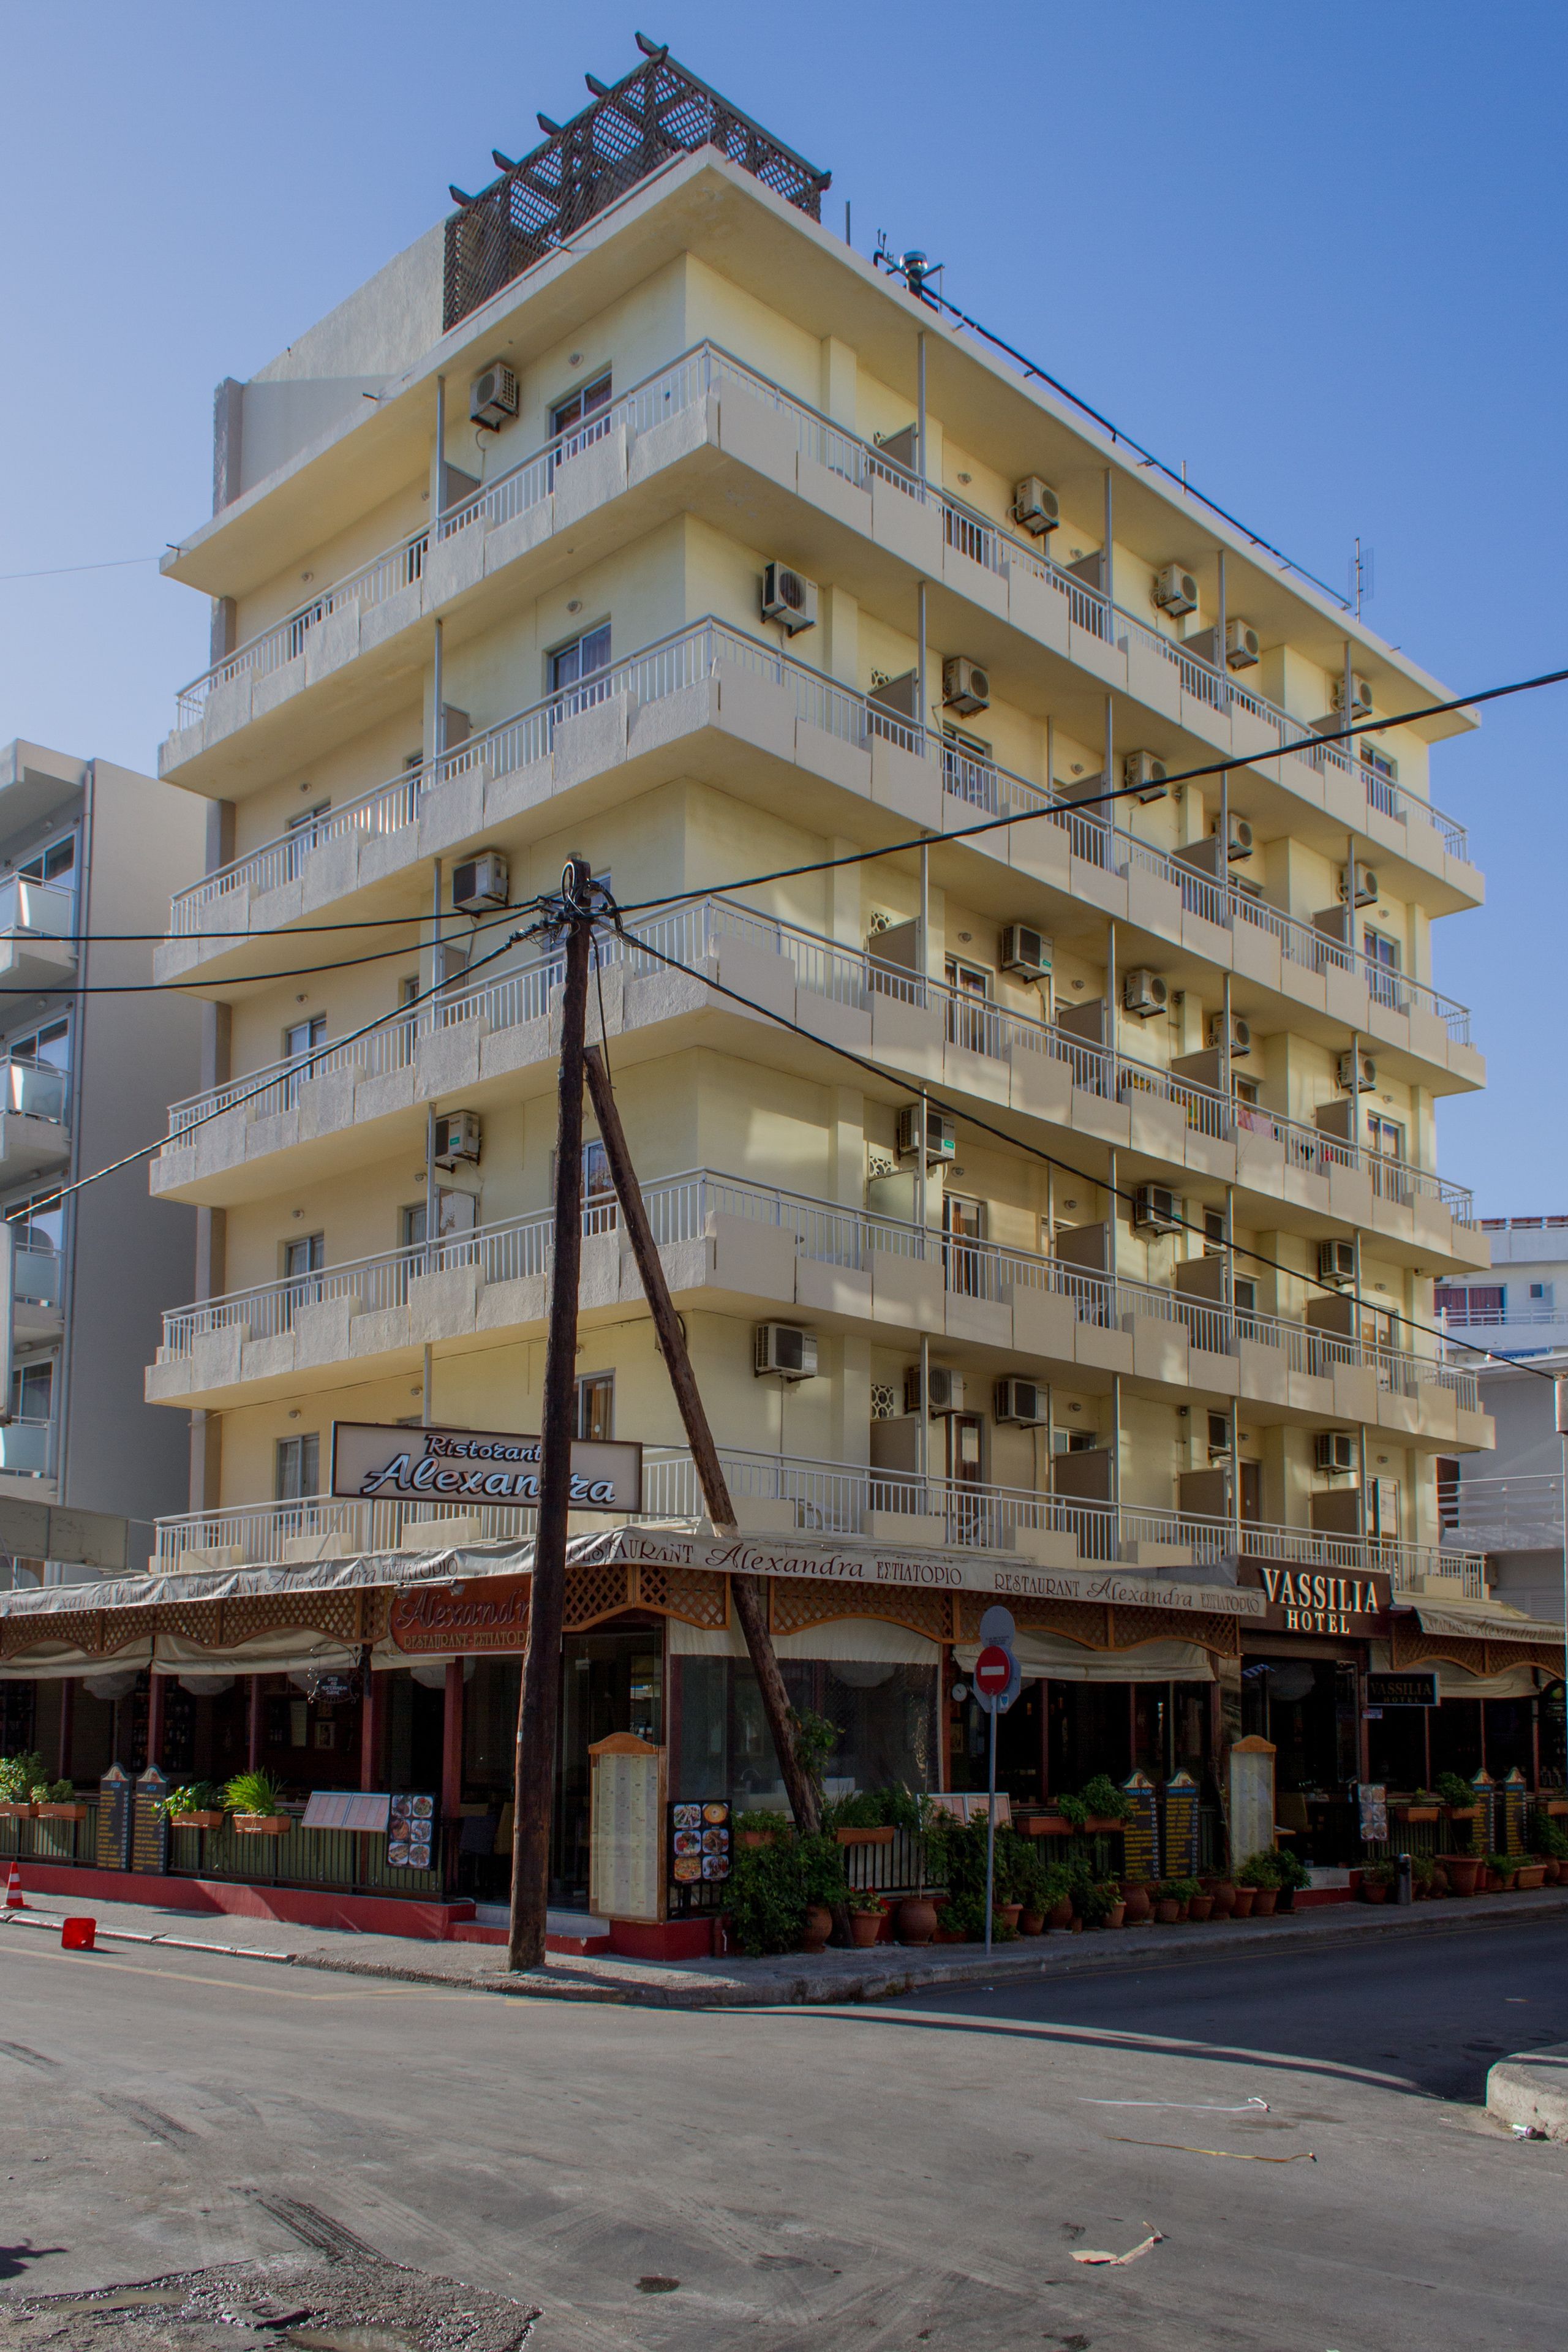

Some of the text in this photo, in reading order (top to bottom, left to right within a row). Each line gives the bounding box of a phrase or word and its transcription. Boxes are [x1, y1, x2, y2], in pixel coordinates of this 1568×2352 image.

[424, 1434, 541, 1463] Ristorant
[360, 1453, 616, 1504] Alexanra
[705, 1543, 865, 1577] Alexandra
[265, 1564, 377, 1593] Alexandra
[995, 1573, 1080, 1597] RESTAURANT
[1087, 1577, 1193, 1607] Alexandra
[1261, 1567, 1380, 1614] VASSILIA
[396, 1589, 531, 1629] Alexandr
[1286, 1609, 1350, 1634] HOTEL
[1471, 1620, 1536, 1640] Alexandra
[1370, 1681, 1433, 1695] VASSILIA
